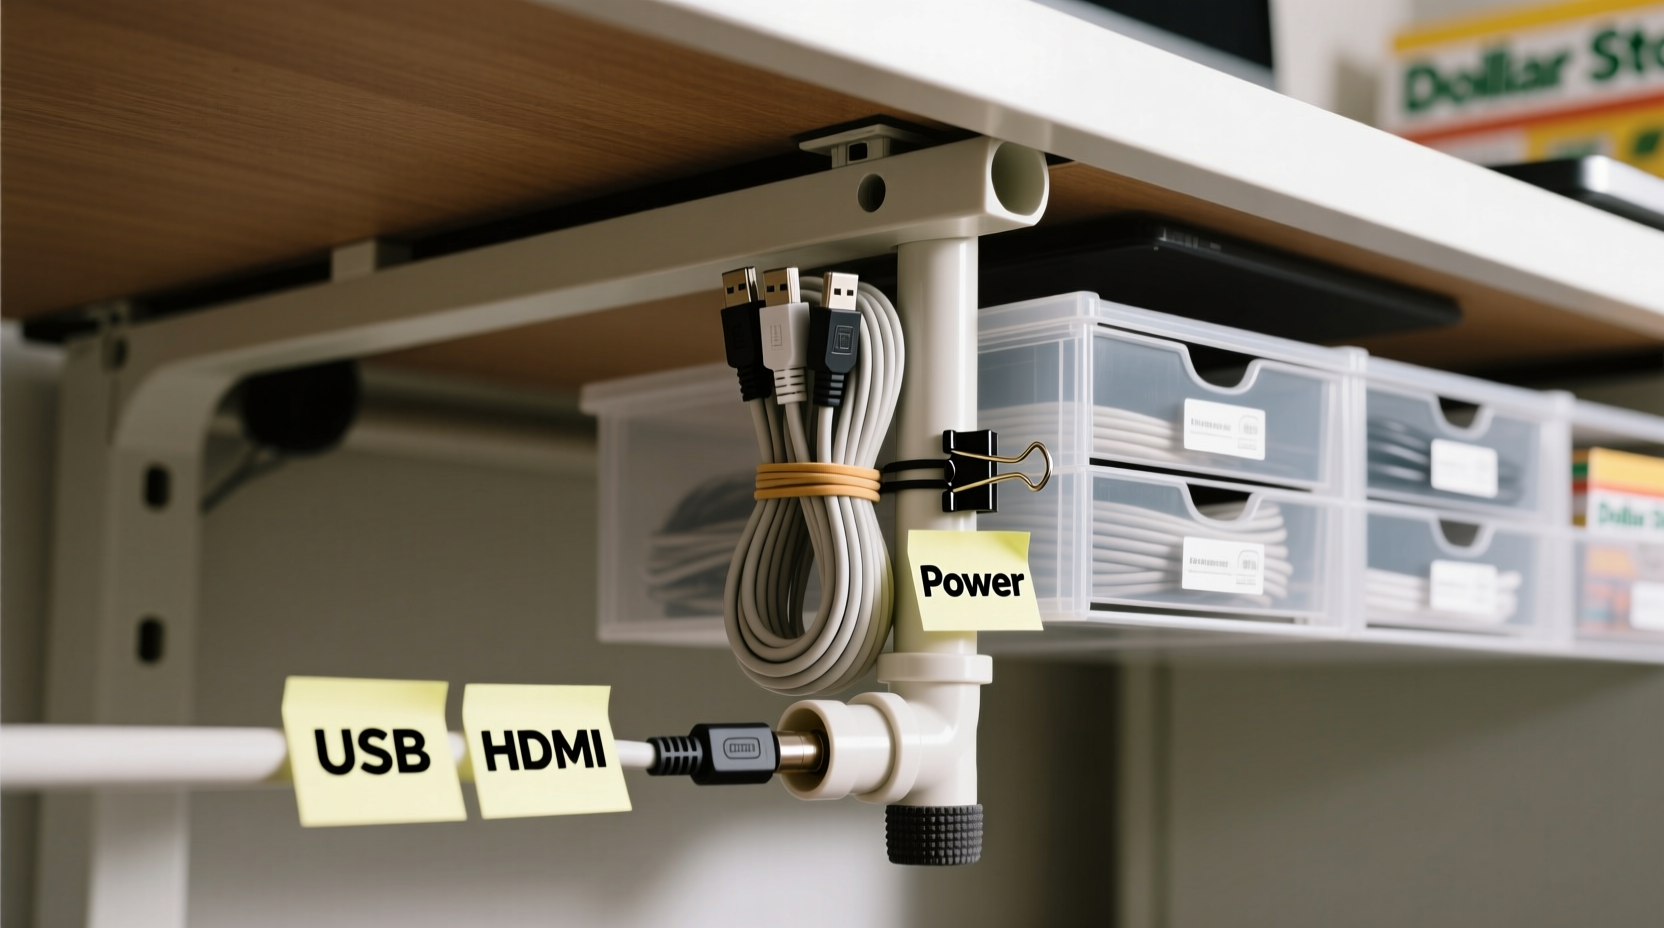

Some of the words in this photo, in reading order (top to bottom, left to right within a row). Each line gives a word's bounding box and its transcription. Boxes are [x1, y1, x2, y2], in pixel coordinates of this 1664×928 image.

[1404, 49, 1571, 112] Dollar
[920, 564, 1025, 598] Power
[314, 727, 431, 775] USB
[481, 729, 607, 771] HDMI
